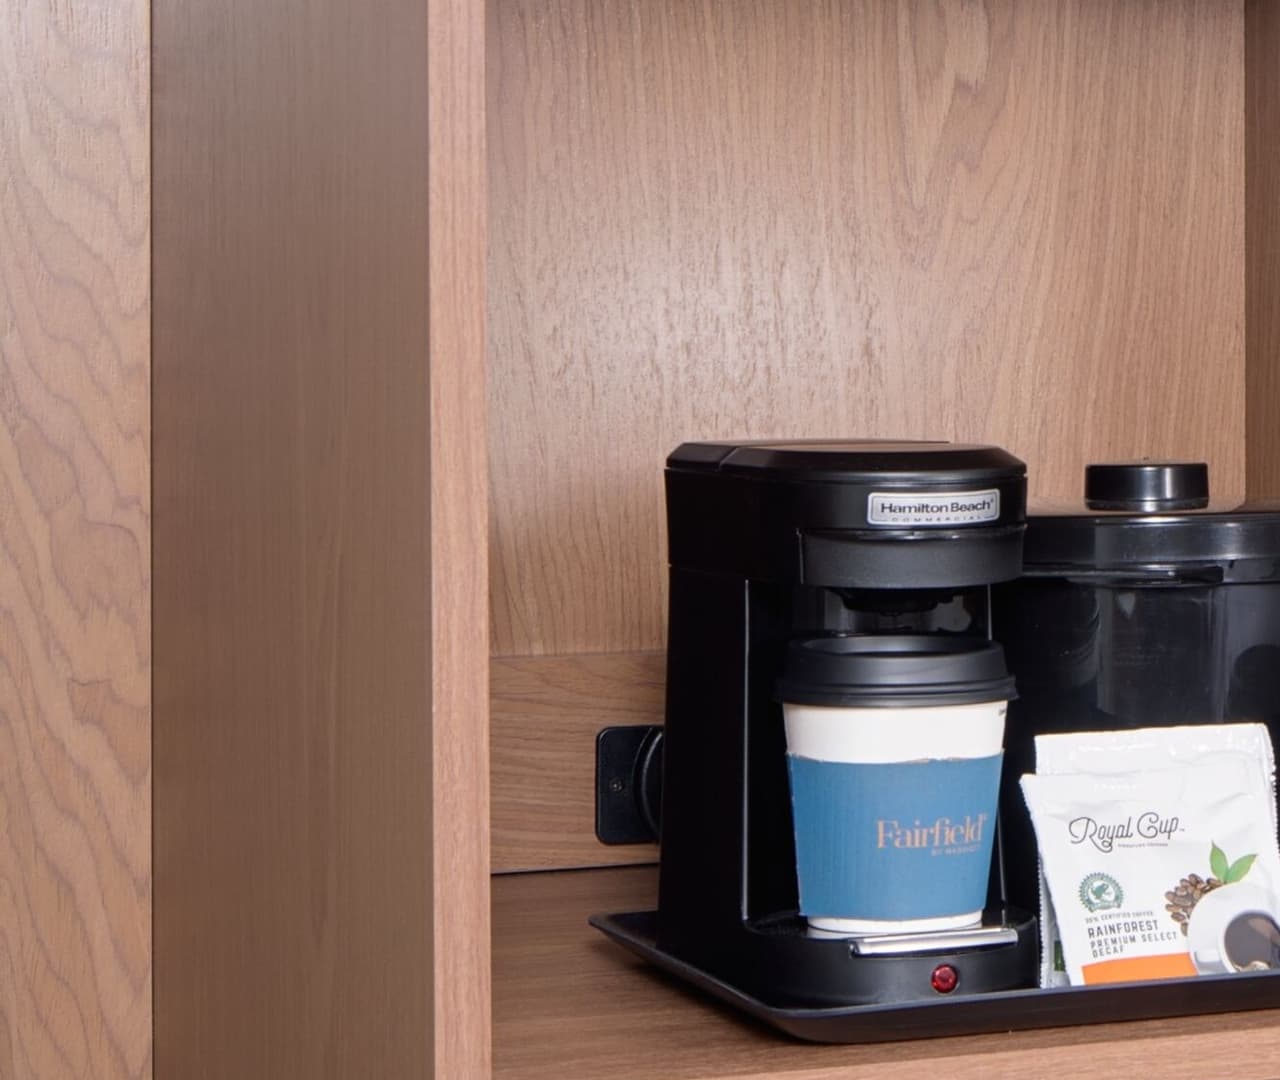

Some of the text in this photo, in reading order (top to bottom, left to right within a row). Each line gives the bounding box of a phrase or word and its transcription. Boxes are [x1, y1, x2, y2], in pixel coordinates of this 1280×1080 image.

[880, 500, 991, 514] Hamilton Beach
[877, 814, 983, 848] Fairfield
[1068, 811, 1179, 853] Royal Cup
[1087, 919, 1159, 939] RAINFOREST
[1090, 931, 1177, 949] PREMIUM SELECT
[1092, 944, 1124, 958] DECAF
